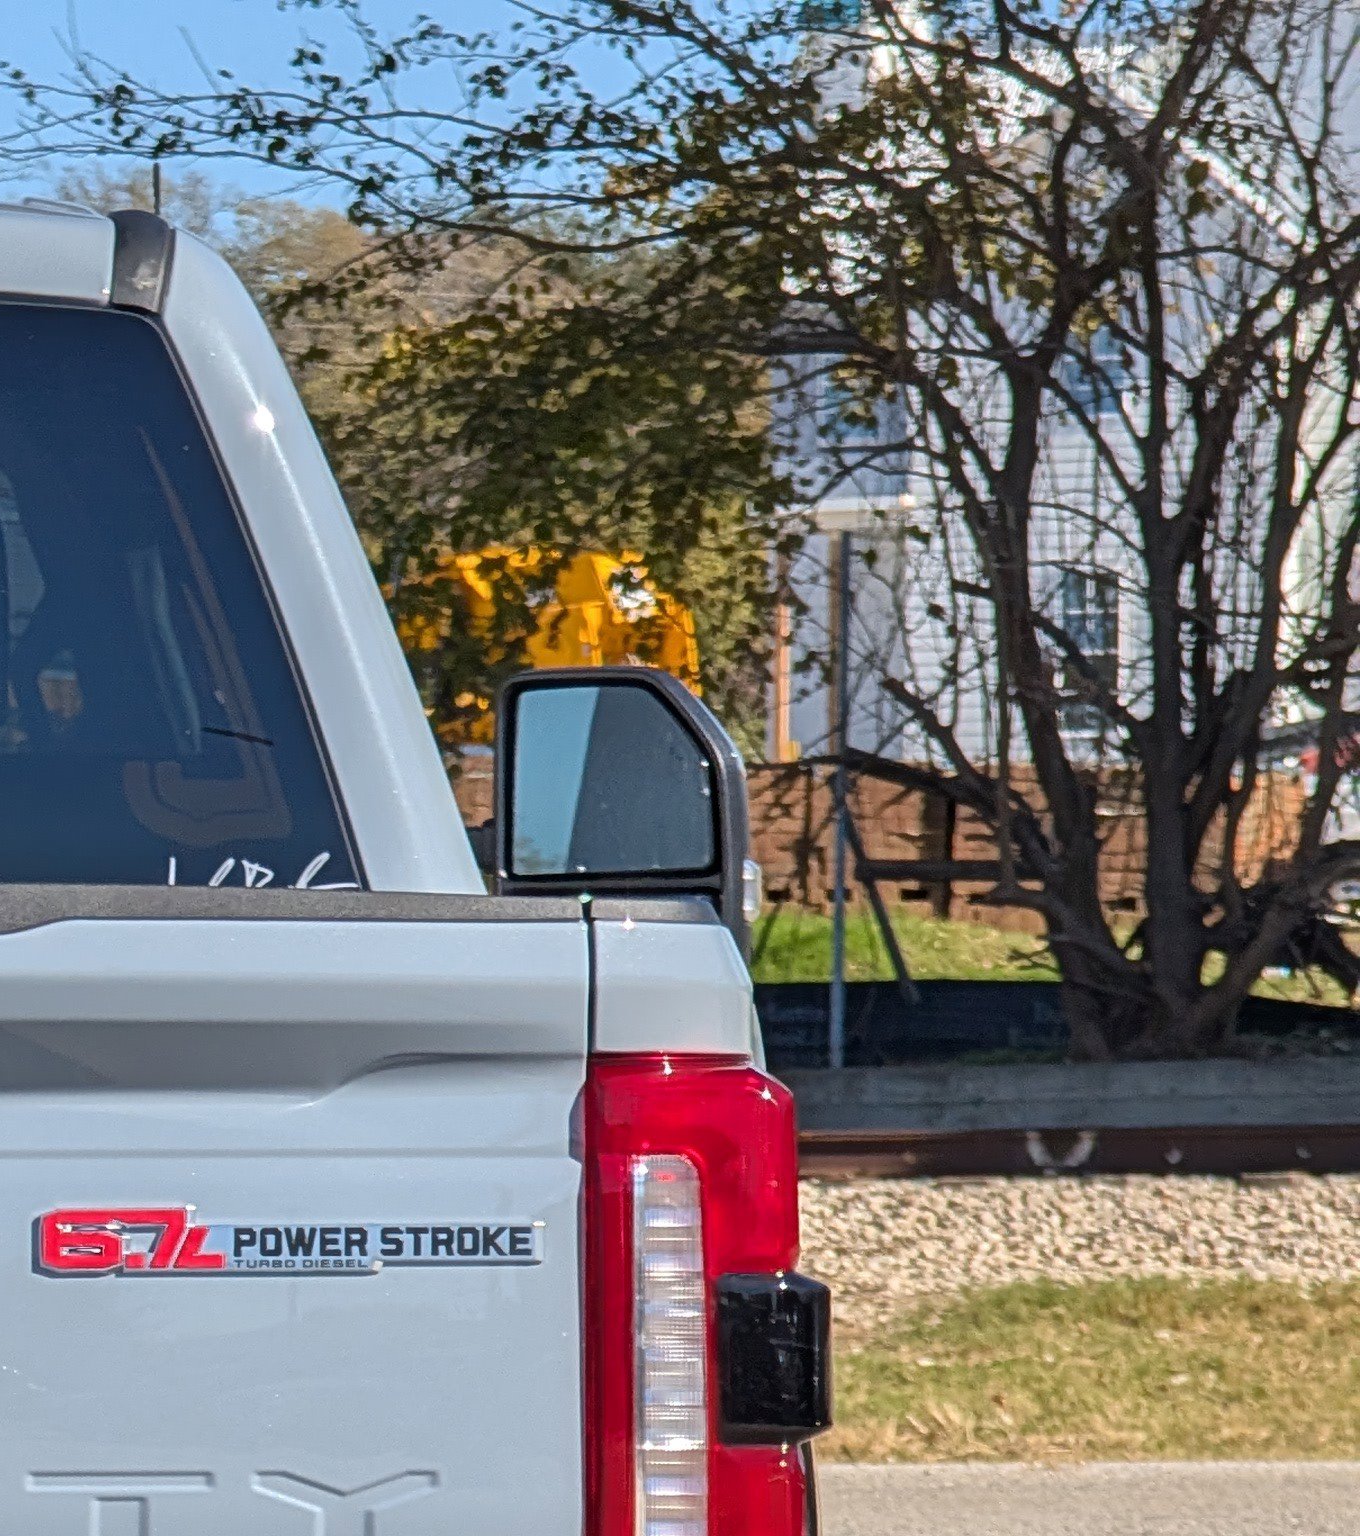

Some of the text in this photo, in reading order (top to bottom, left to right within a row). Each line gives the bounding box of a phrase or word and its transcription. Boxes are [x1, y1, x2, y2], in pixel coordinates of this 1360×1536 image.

[36, 1206, 533, 1272] 6.7L POWER STROKE
[234, 1258, 369, 1270] TURBO DIESEL
